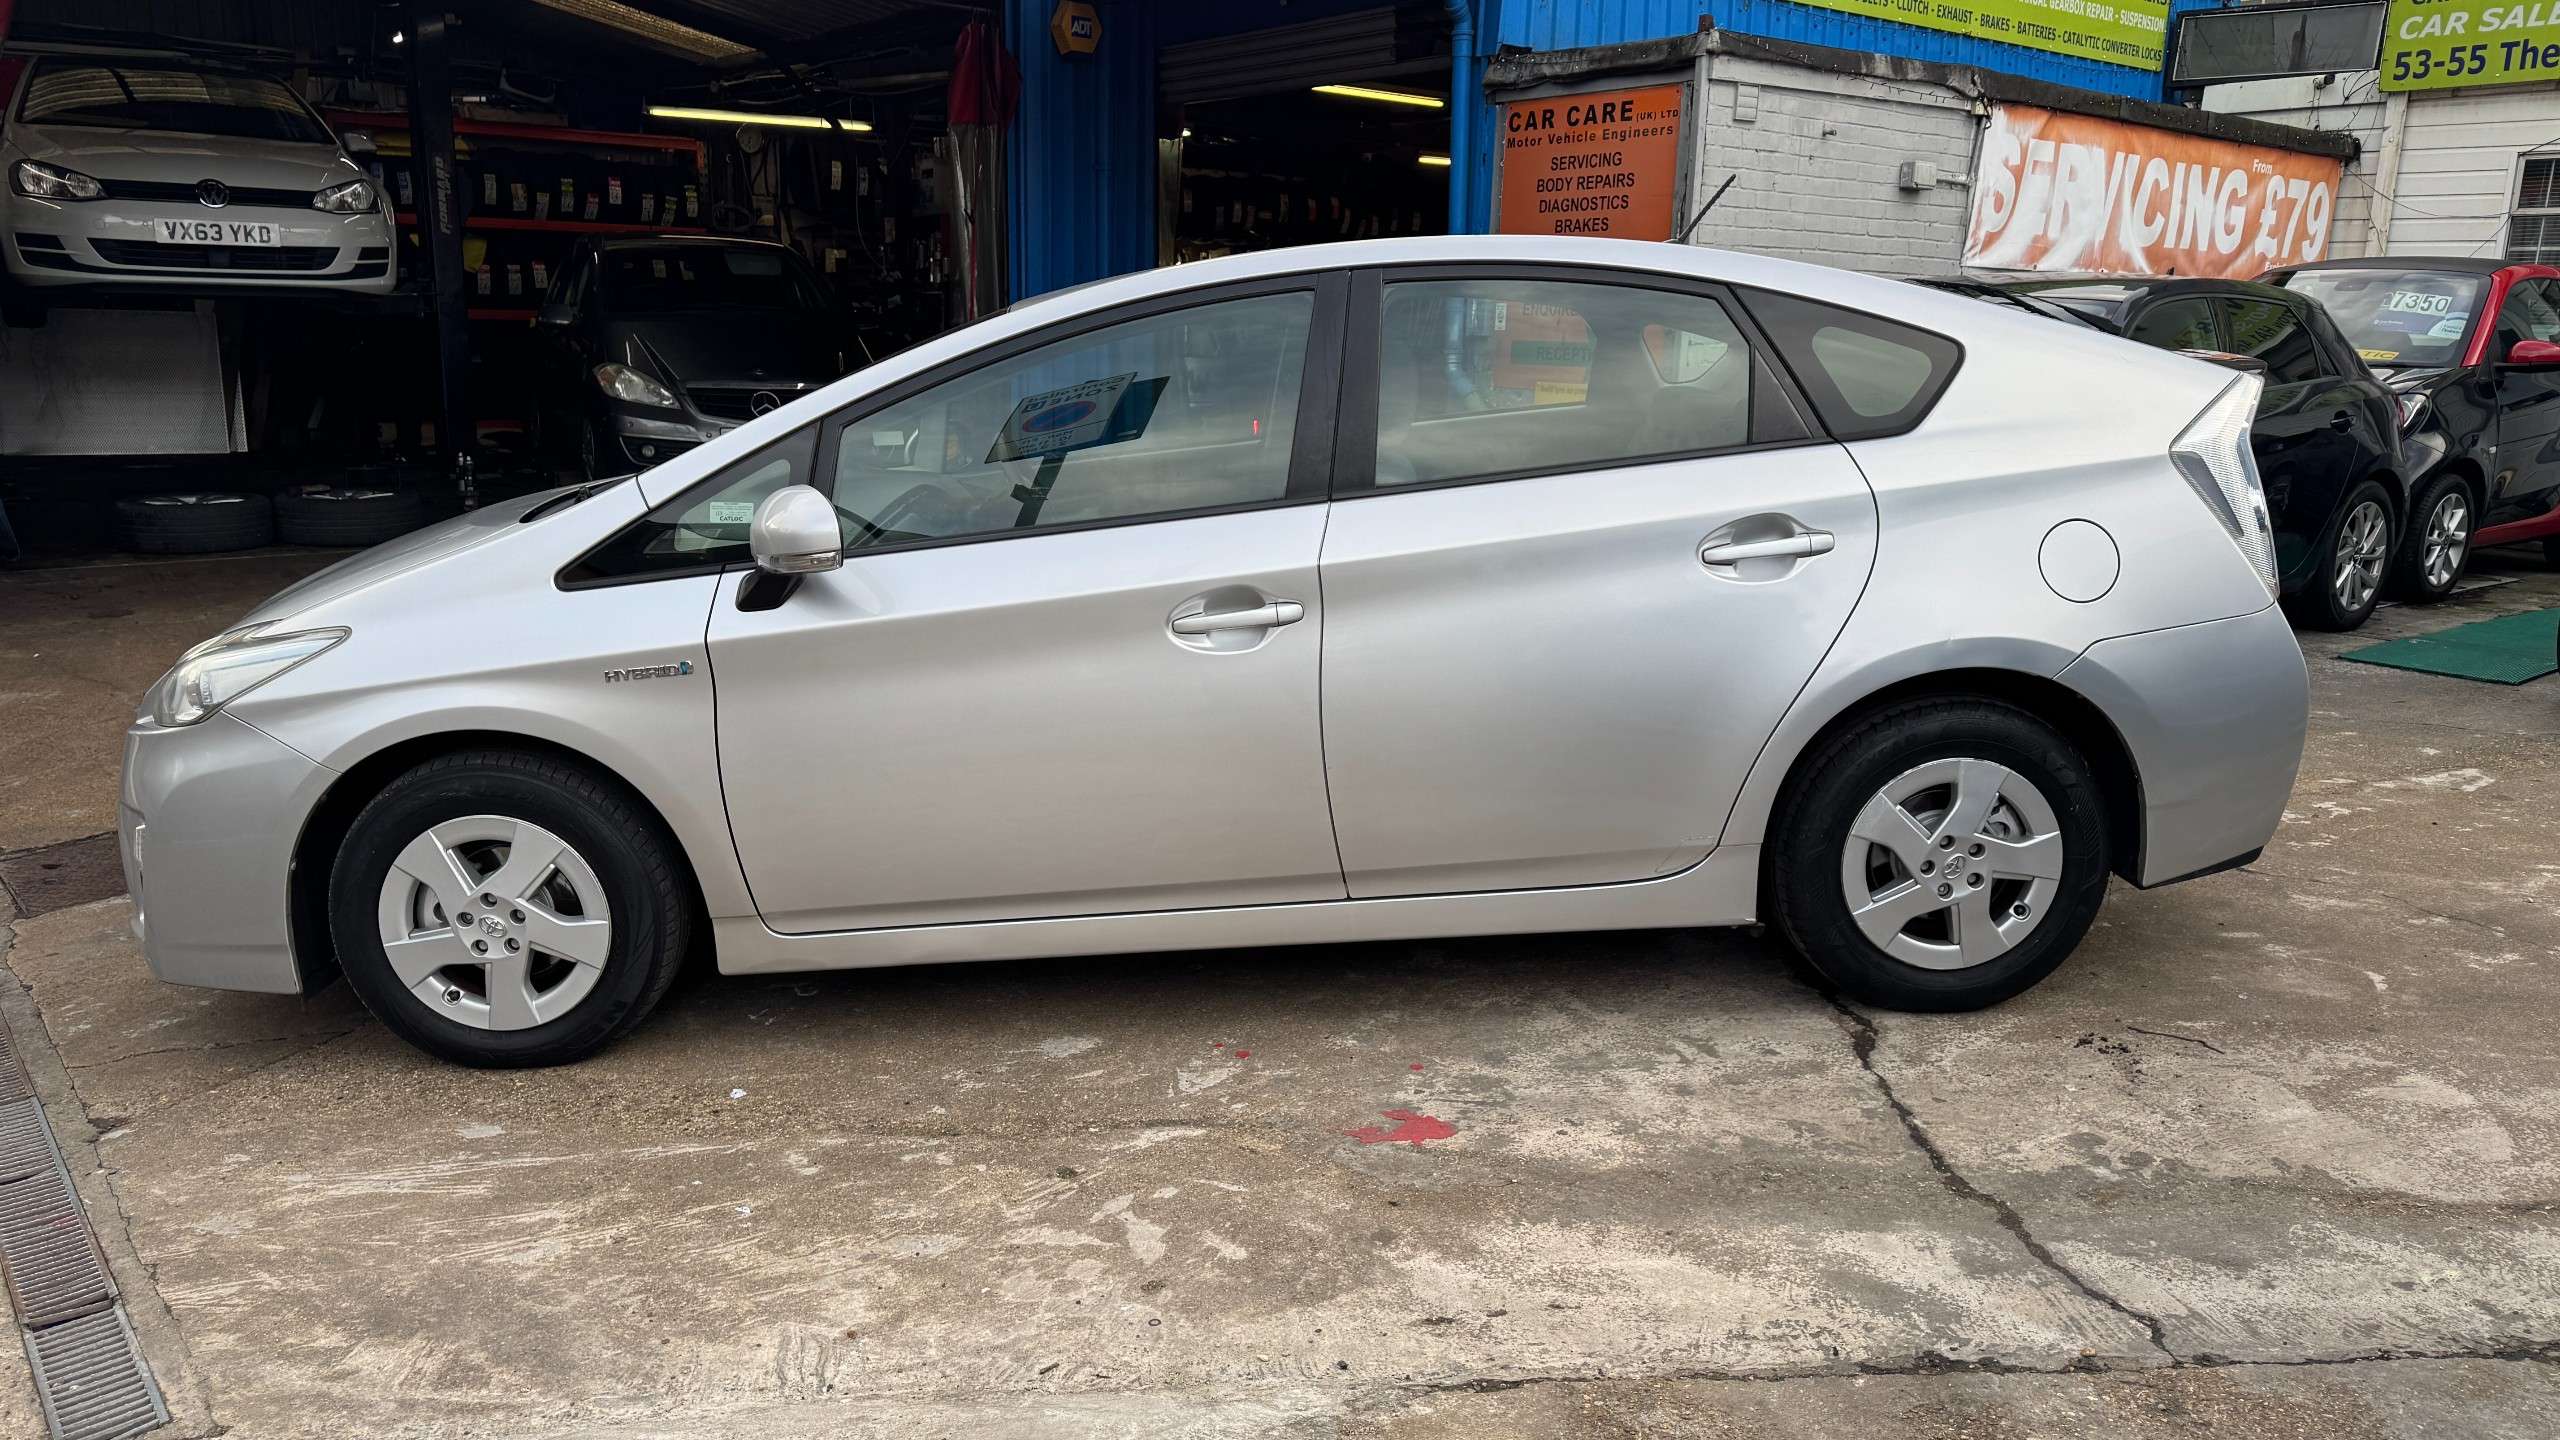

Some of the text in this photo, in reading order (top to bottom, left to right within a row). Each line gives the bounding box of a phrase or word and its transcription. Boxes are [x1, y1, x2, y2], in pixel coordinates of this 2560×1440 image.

[2087, 4, 2113, 20] REPAIR
[1072, 20, 1092, 36] ADT
[1897, 0, 1929, 15] CLUTCH
[1937, 4, 1973, 24] EXHAUST
[1980, 14, 2011, 32] BRAKES
[2017, 23, 2056, 41] BATTERIES
[2062, 31, 2101, 50] CATALYTIC
[2102, 38, 2140, 58] CONVERTER
[2141, 45, 2162, 62] LOCKS
[2400, 12, 2469, 40] CAR
[2393, 44, 2488, 81] 53-55
[1508, 100, 1679, 132] CAR CARE (UK) LTD
[1507, 126, 1674, 149] Motor Vehicle Engineers
[1550, 151, 1623, 171] SERVICING
[2252, 159, 2273, 175] From
[1536, 172, 1635, 193] BODY REPAIRS
[1981, 130, 2248, 255] SERVICING
[1538, 195, 1629, 214] DIAGNOSTICS
[1554, 217, 1609, 234] BRAKES
[2254, 174, 2330, 262] £79
[164, 221, 272, 244] VX63 YKD
[2392, 292, 2449, 312] 7350
[604, 664, 680, 683] HYBRID
